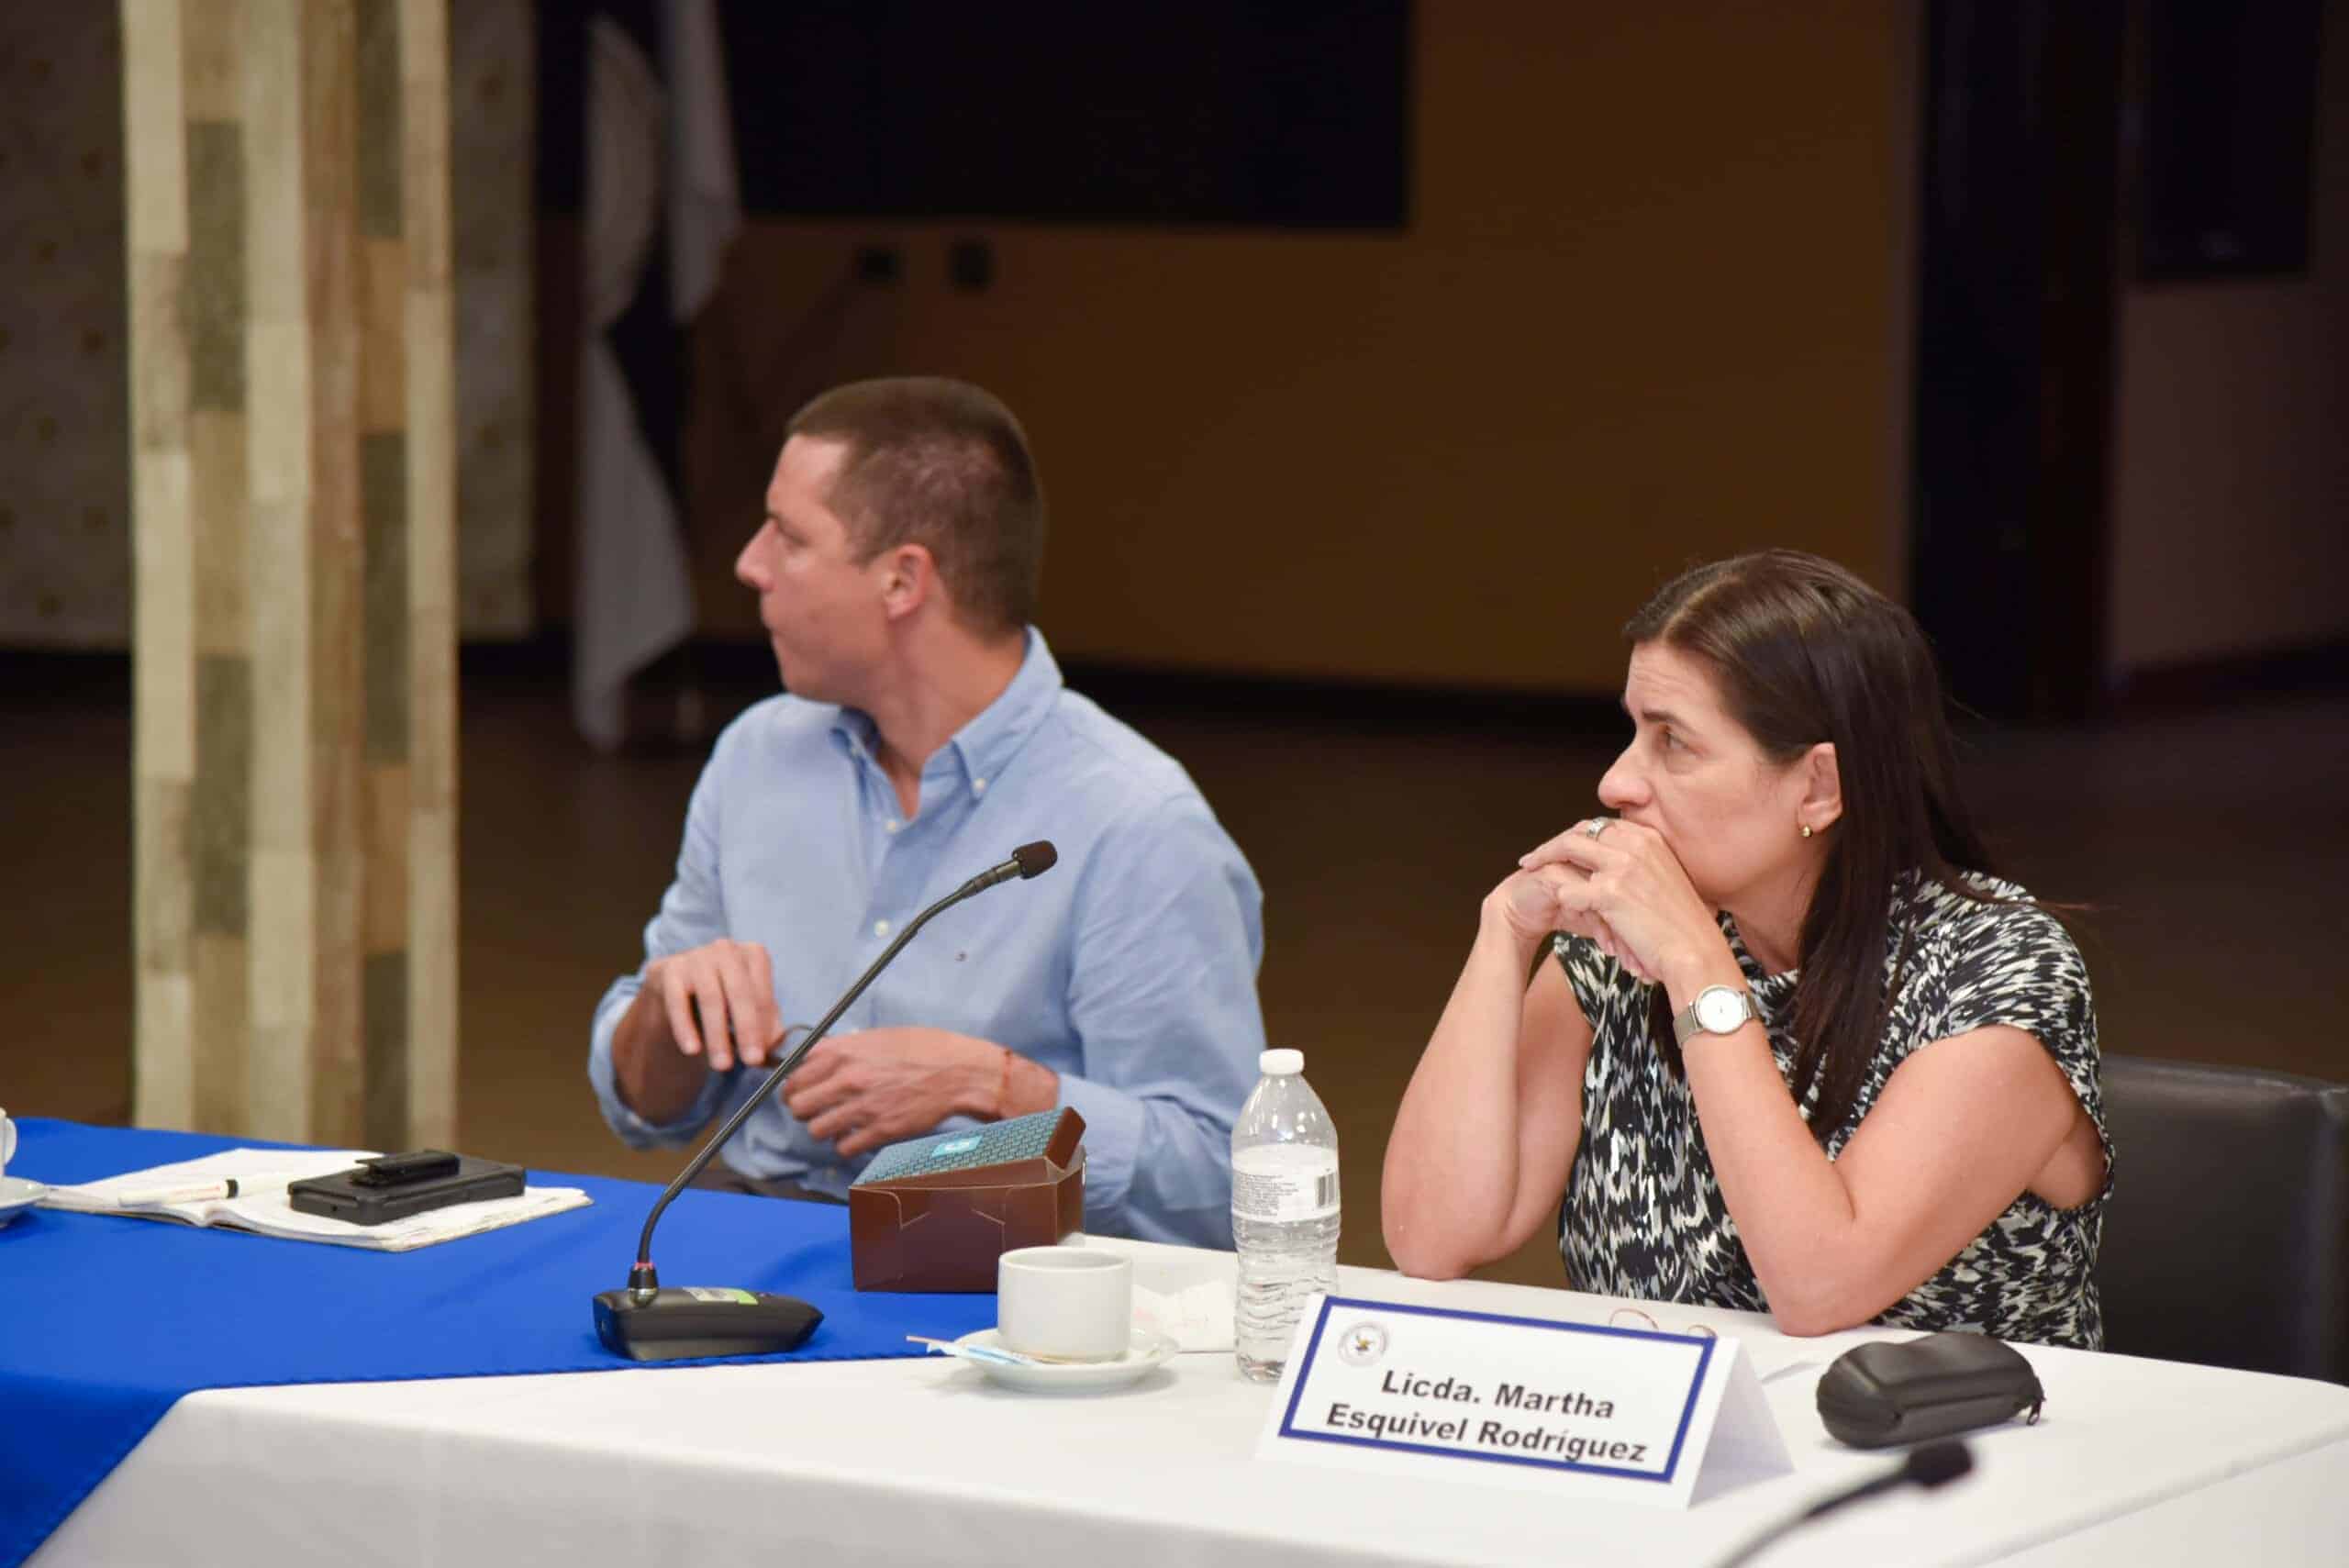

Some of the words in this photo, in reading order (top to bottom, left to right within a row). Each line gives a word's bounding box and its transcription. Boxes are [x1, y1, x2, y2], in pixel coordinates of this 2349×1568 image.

[1381, 1369, 1481, 1404] Licda.
[1494, 1383, 1615, 1419] Martha
[1326, 1402, 1469, 1441] Esquivel
